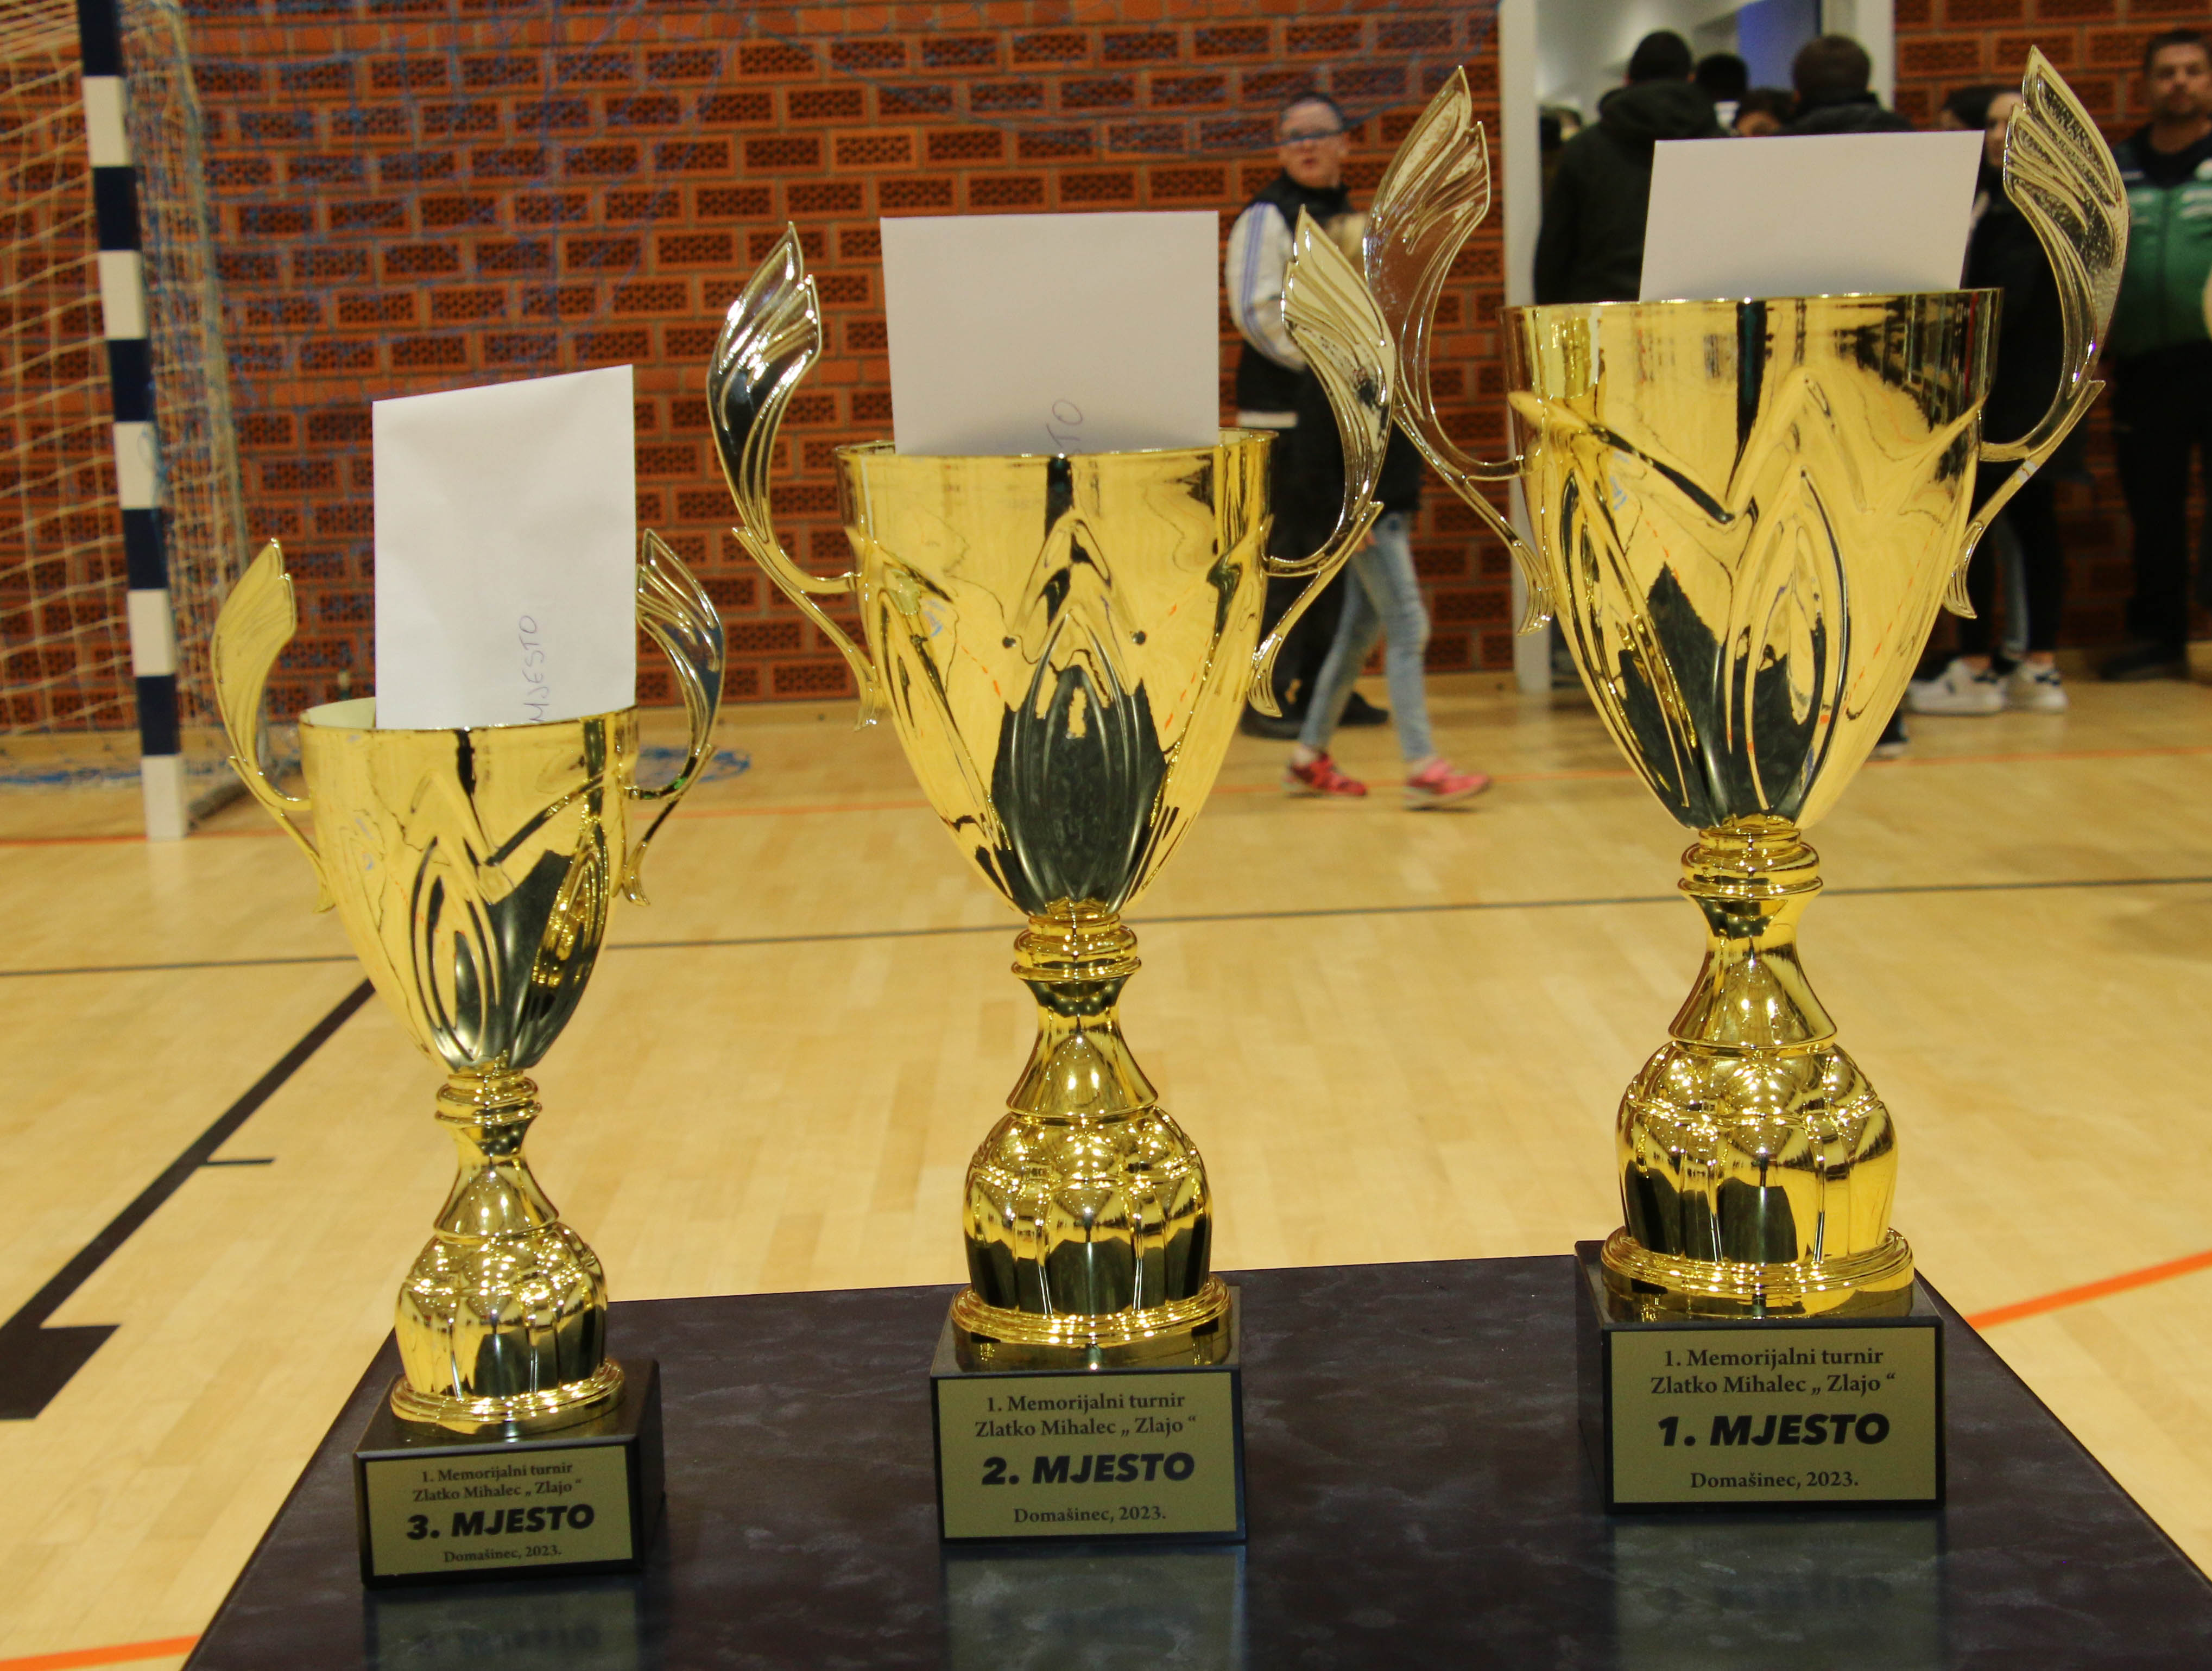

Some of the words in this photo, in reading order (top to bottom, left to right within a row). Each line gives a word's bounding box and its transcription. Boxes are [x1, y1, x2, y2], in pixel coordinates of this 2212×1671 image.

[1665, 1350, 1682, 1367] 1.
[1686, 1346, 1816, 1371] Memorijalni
[1821, 1347, 1884, 1365] turnir
[1651, 1375, 1717, 1394] Zlatko
[1723, 1374, 1806, 1393] Mihalec
[987, 1397, 1002, 1412] 1.
[1007, 1392, 1124, 1415] Memorijalni
[1129, 1392, 1185, 1409] turnir
[975, 1420, 1036, 1438] Zlatko
[1041, 1417, 1116, 1436] Mihalec
[1658, 1416, 1696, 1447] 1.
[1709, 1412, 1890, 1447] MJESTO
[422, 1470, 434, 1483] 1.
[438, 1464, 527, 1482] Memorijalni
[530, 1463, 573, 1476] turnir
[981, 1456, 1020, 1486] 2.
[1032, 1452, 1195, 1484] MJESTO
[1690, 1472, 1801, 1490] Domašinec,
[1806, 1471, 1859, 1488] 2023.
[412, 1485, 460, 1502] Zlatko
[464, 1484, 521, 1499] Mihalec
[406, 1514, 440, 1541] 3.
[451, 1503, 595, 1537] MJESTO
[1014, 1507, 1114, 1523] Domašinec,
[1119, 1505, 1166, 1520] 2023.
[444, 1549, 522, 1563] Domašinec,
[526, 1545, 562, 1558] 2023.
